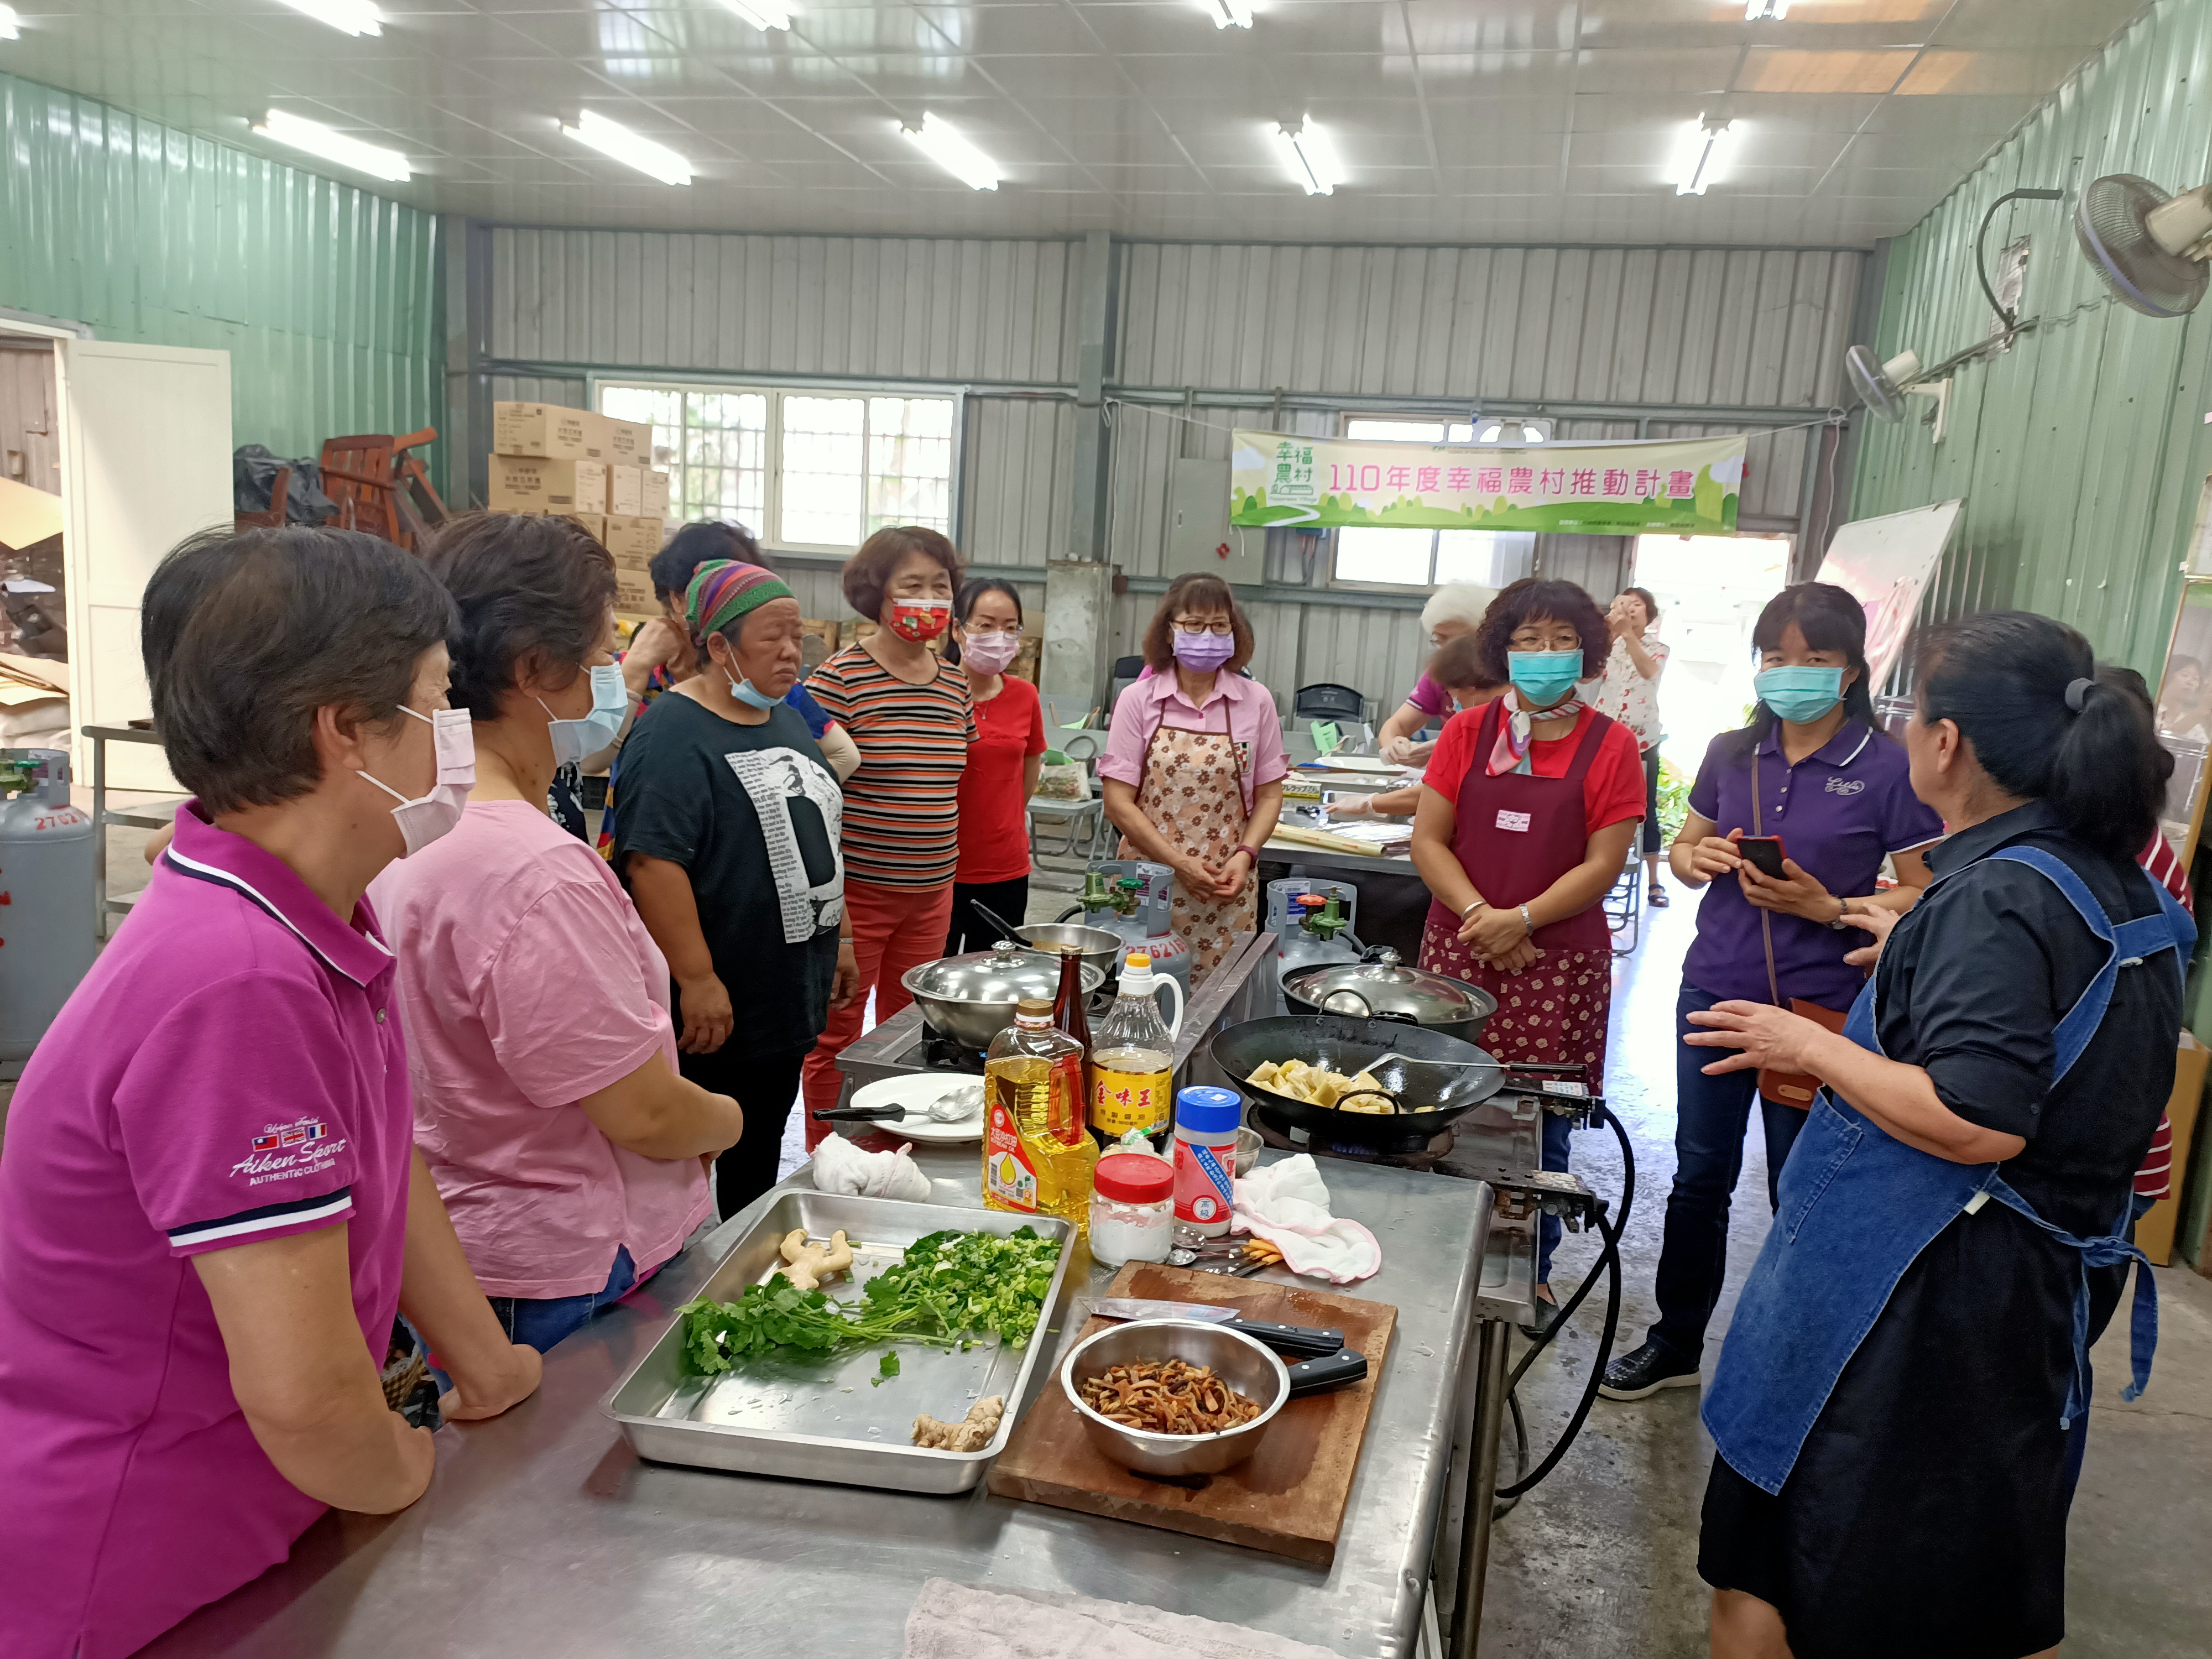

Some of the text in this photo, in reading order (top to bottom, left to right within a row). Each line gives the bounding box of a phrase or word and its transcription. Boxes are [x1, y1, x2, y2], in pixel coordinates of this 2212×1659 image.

[1276, 442, 1313, 465] 幸福
[1274, 463, 1313, 483] 農村
[1329, 464, 1694, 497] 110年度幸福農村推動計畫
[1094, 1079, 1152, 1108] 金味王
[296, 1138, 347, 1165] Sport
[249, 1158, 336, 1186] AUTHENTIC CLOTHING
[1199, 1200, 1211, 1217] 高級
